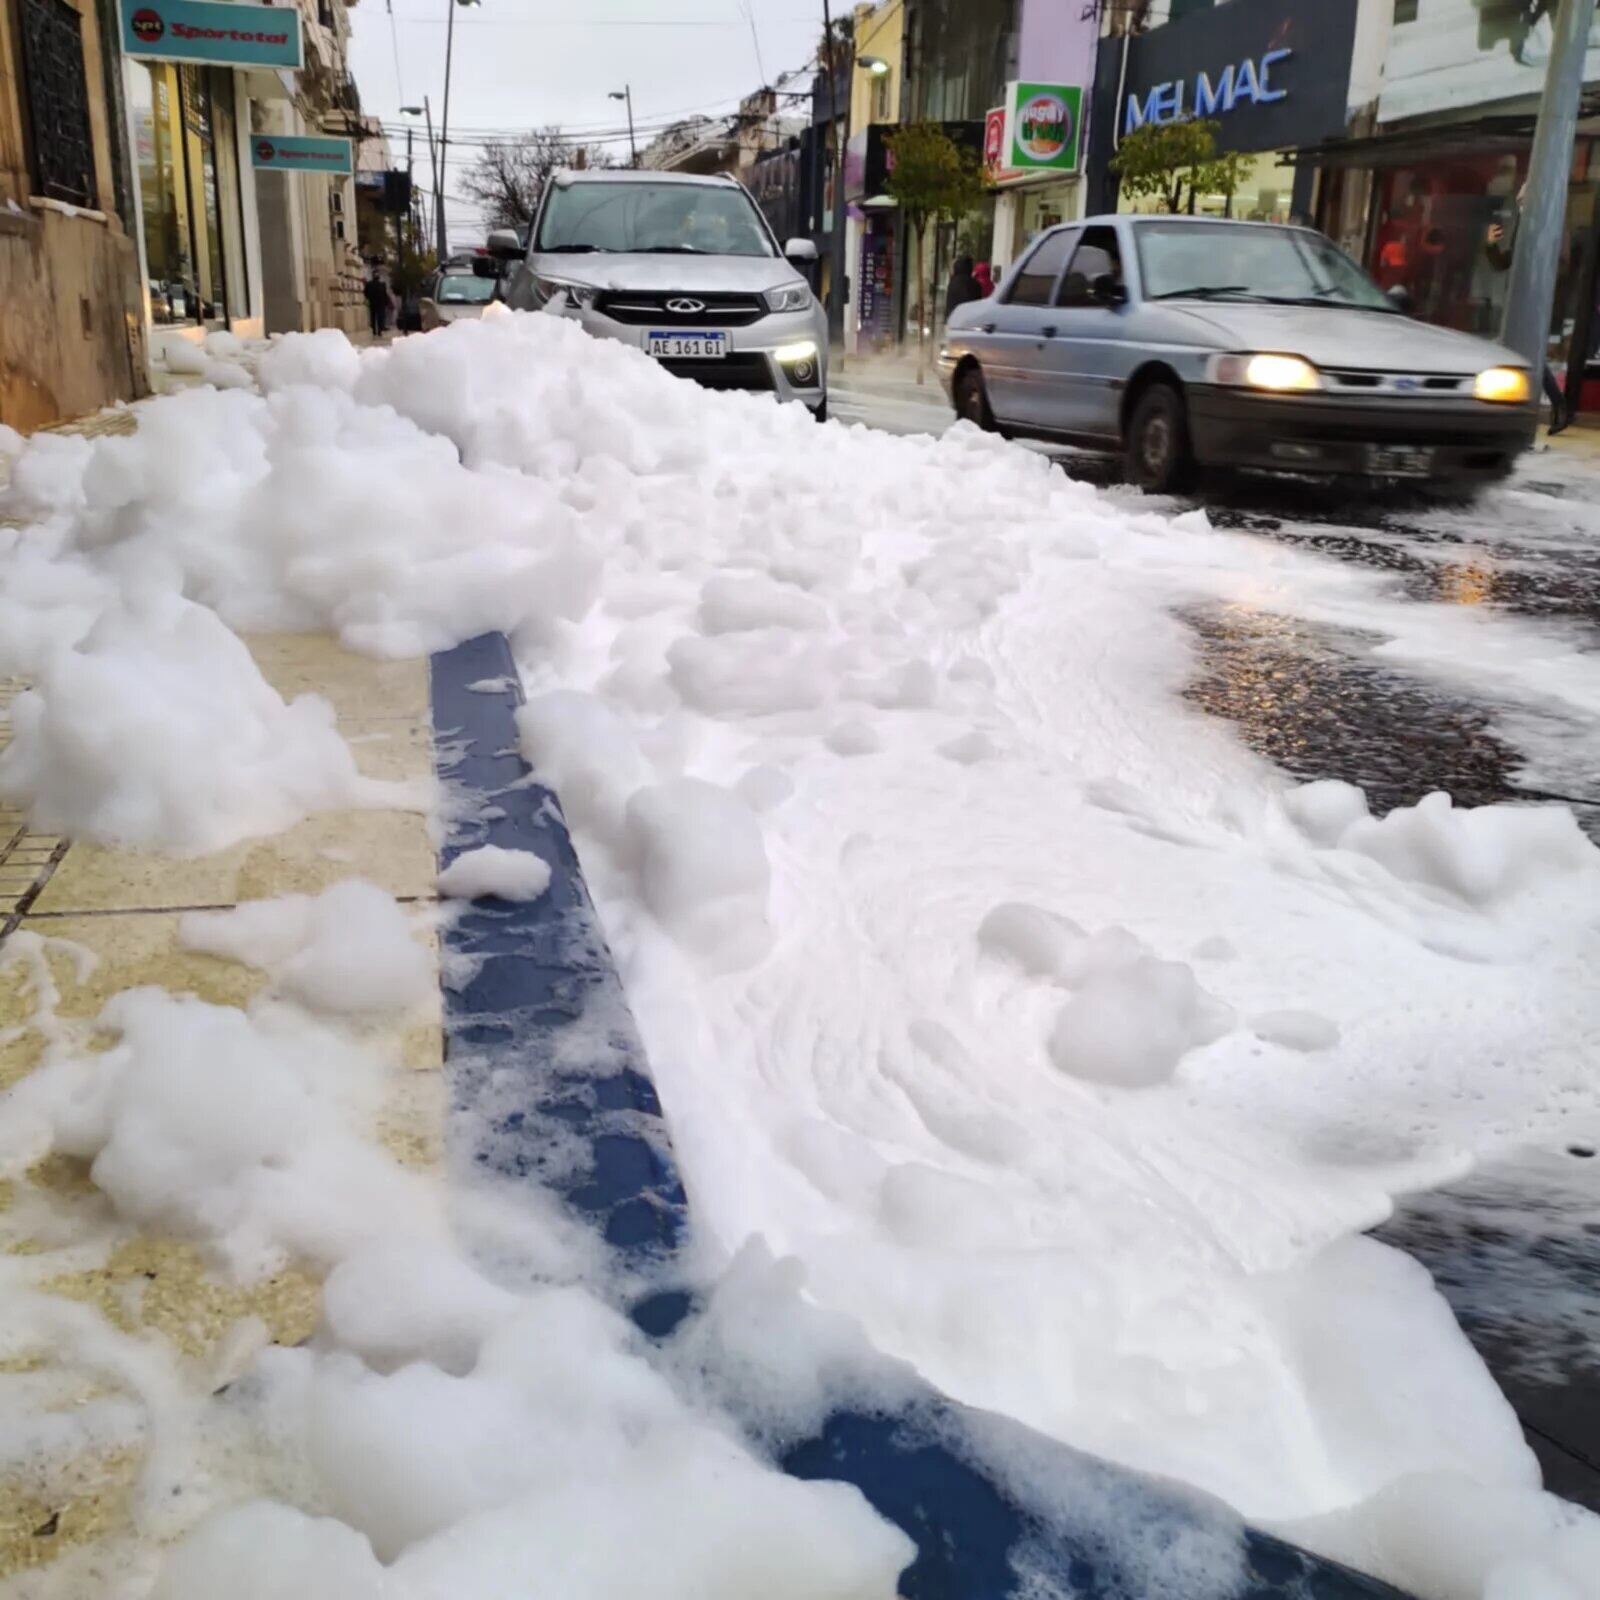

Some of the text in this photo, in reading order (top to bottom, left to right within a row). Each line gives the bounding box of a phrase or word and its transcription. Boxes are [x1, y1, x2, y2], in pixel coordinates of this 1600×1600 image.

[170, 22, 288, 45] Sportotal
[1125, 48, 1292, 136] MELMAC
[653, 340, 670, 355] AE
[675, 340, 700, 355] 161
